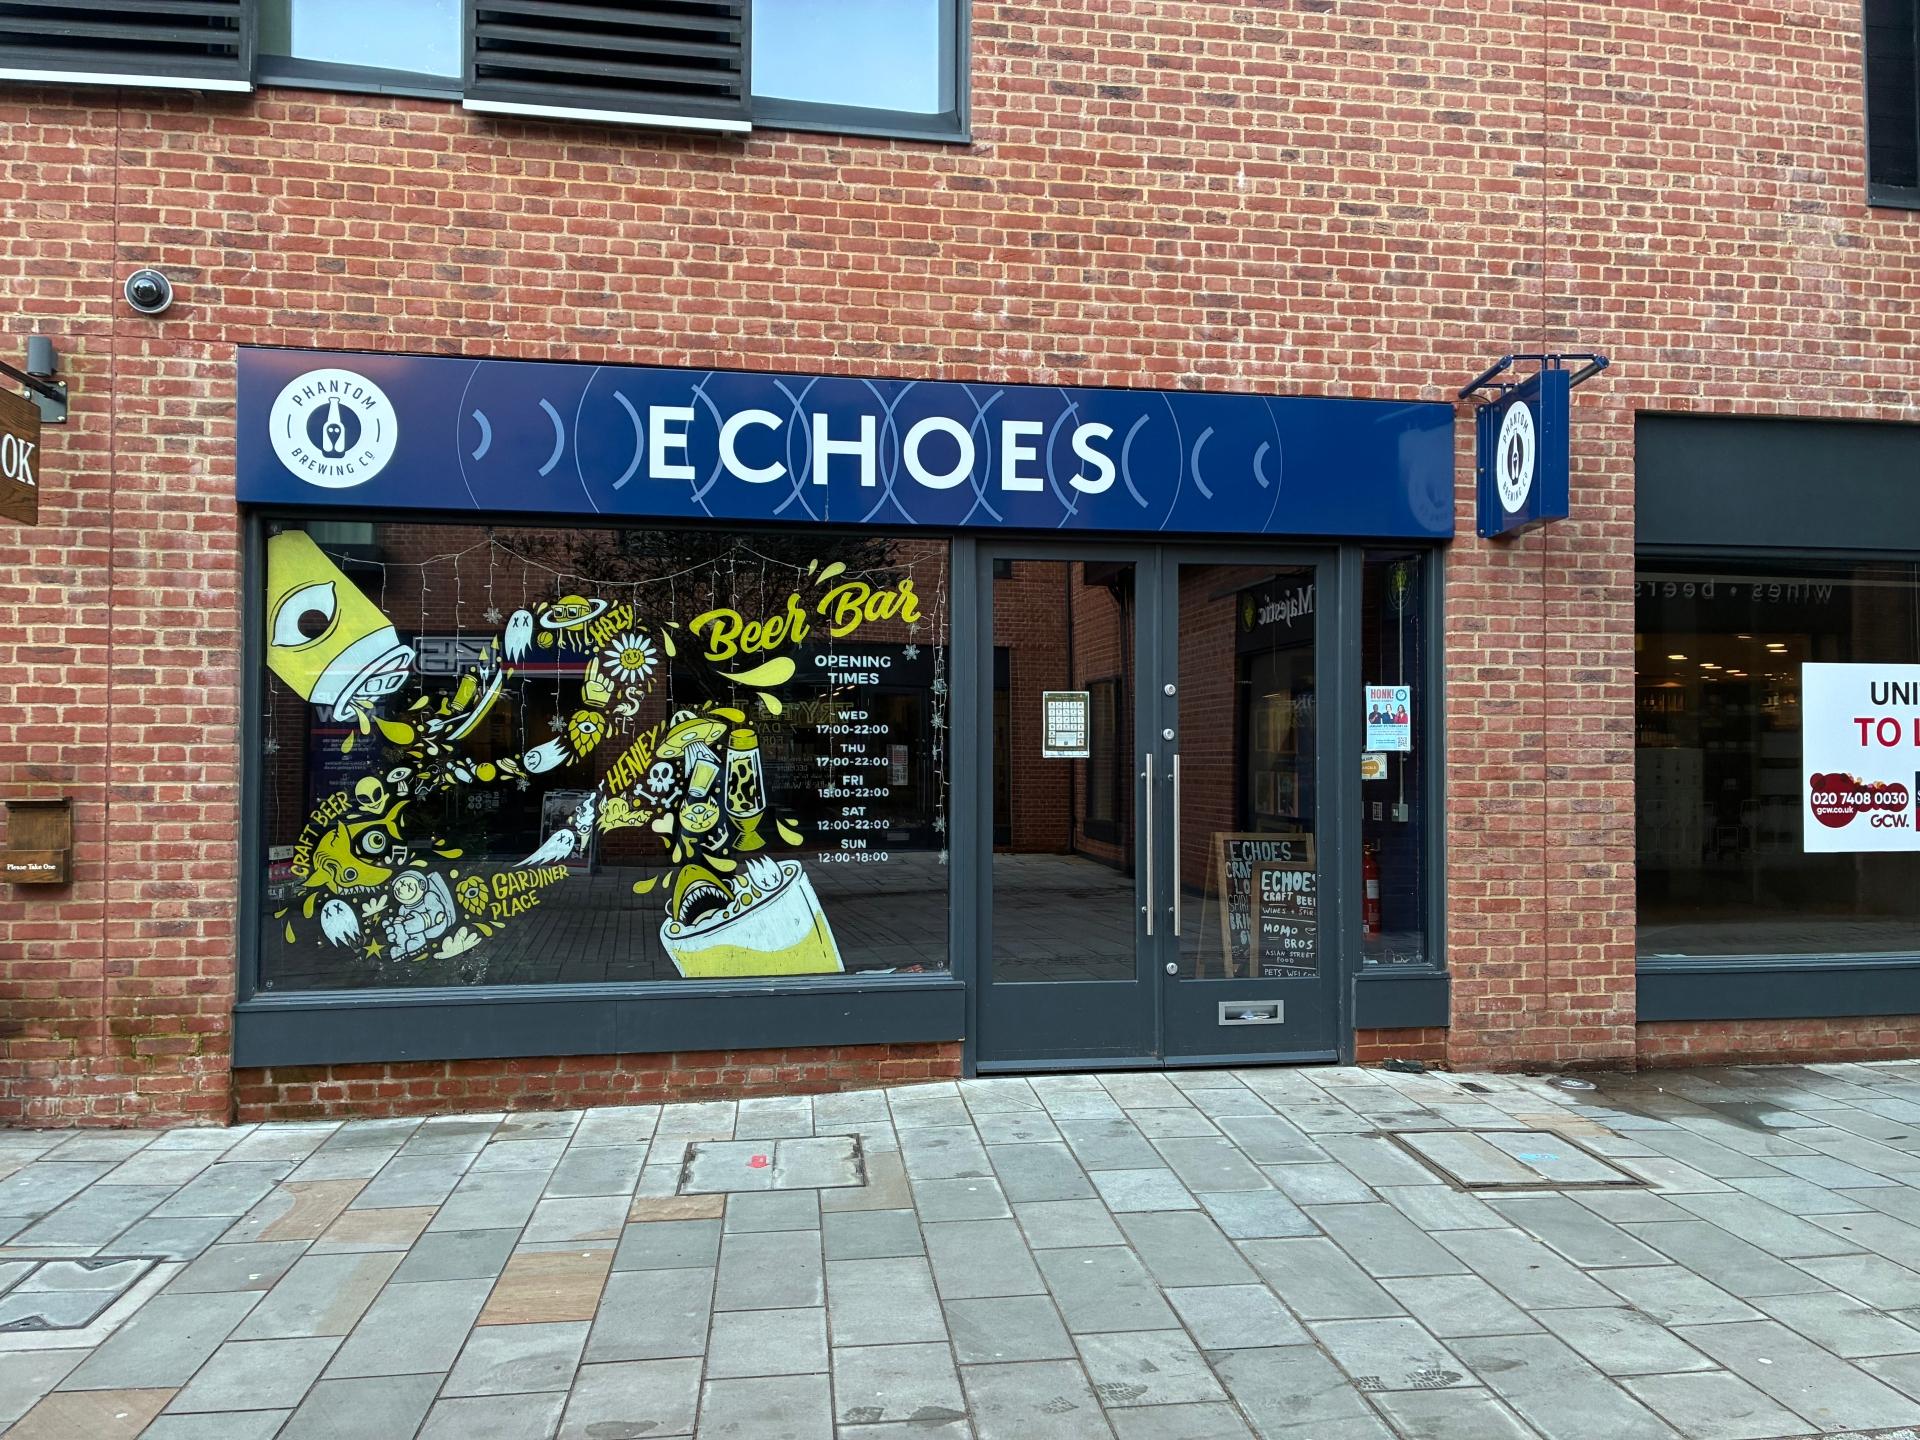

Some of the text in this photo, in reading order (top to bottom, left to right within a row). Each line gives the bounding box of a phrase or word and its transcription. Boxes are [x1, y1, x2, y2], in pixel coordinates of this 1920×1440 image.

[292, 379, 377, 410] PHANTOM
[1502, 411, 1529, 444] PHANTOM
[649, 405, 1116, 494] ECHOES
[1, 433, 36, 487] OK
[291, 447, 355, 476] BREWING
[1502, 481, 1522, 502] BREWING
[590, 604, 634, 648] HAZY
[689, 578, 922, 662] Beer Bar
[814, 655, 891, 668] OPENING
[827, 672, 879, 684] TIMES
[1870, 681, 1920, 706] UNI
[838, 710, 868, 720] WED
[816, 724, 889, 734] 17:00-22:00
[1853, 717, 1902, 747] TO
[840, 743, 866, 753] THU
[606, 725, 659, 794] HENLEY
[816, 757, 889, 767] 17:00-22:00
[842, 775, 864, 786] FRI
[818, 788, 889, 798] 15:00-22:00
[1812, 792, 1838, 805] 020
[1840, 792, 1871, 805] 7408
[1874, 792, 1908, 805] 0030
[841, 806, 867, 816] SAT
[1816, 805, 1854, 815] gcw.co.uk
[817, 820, 890, 830] 12:00-22:00
[1870, 813, 1910, 828] GCW.
[290, 823, 319, 877] CRAFT
[310, 791, 353, 829] BEER
[841, 839, 867, 849] SUN
[818, 852, 888, 863] 12:00-18:00
[1229, 841, 1292, 862] ECHOES
[1226, 861, 1252, 879] CRAF
[491, 864, 570, 900] GARDINER
[1263, 891, 1294, 902] CRAFT
[489, 889, 541, 920] PLACE
[1263, 923, 1298, 937] MOMO
[1284, 938, 1314, 950] BROS
[1264, 968, 1282, 977] PETS
